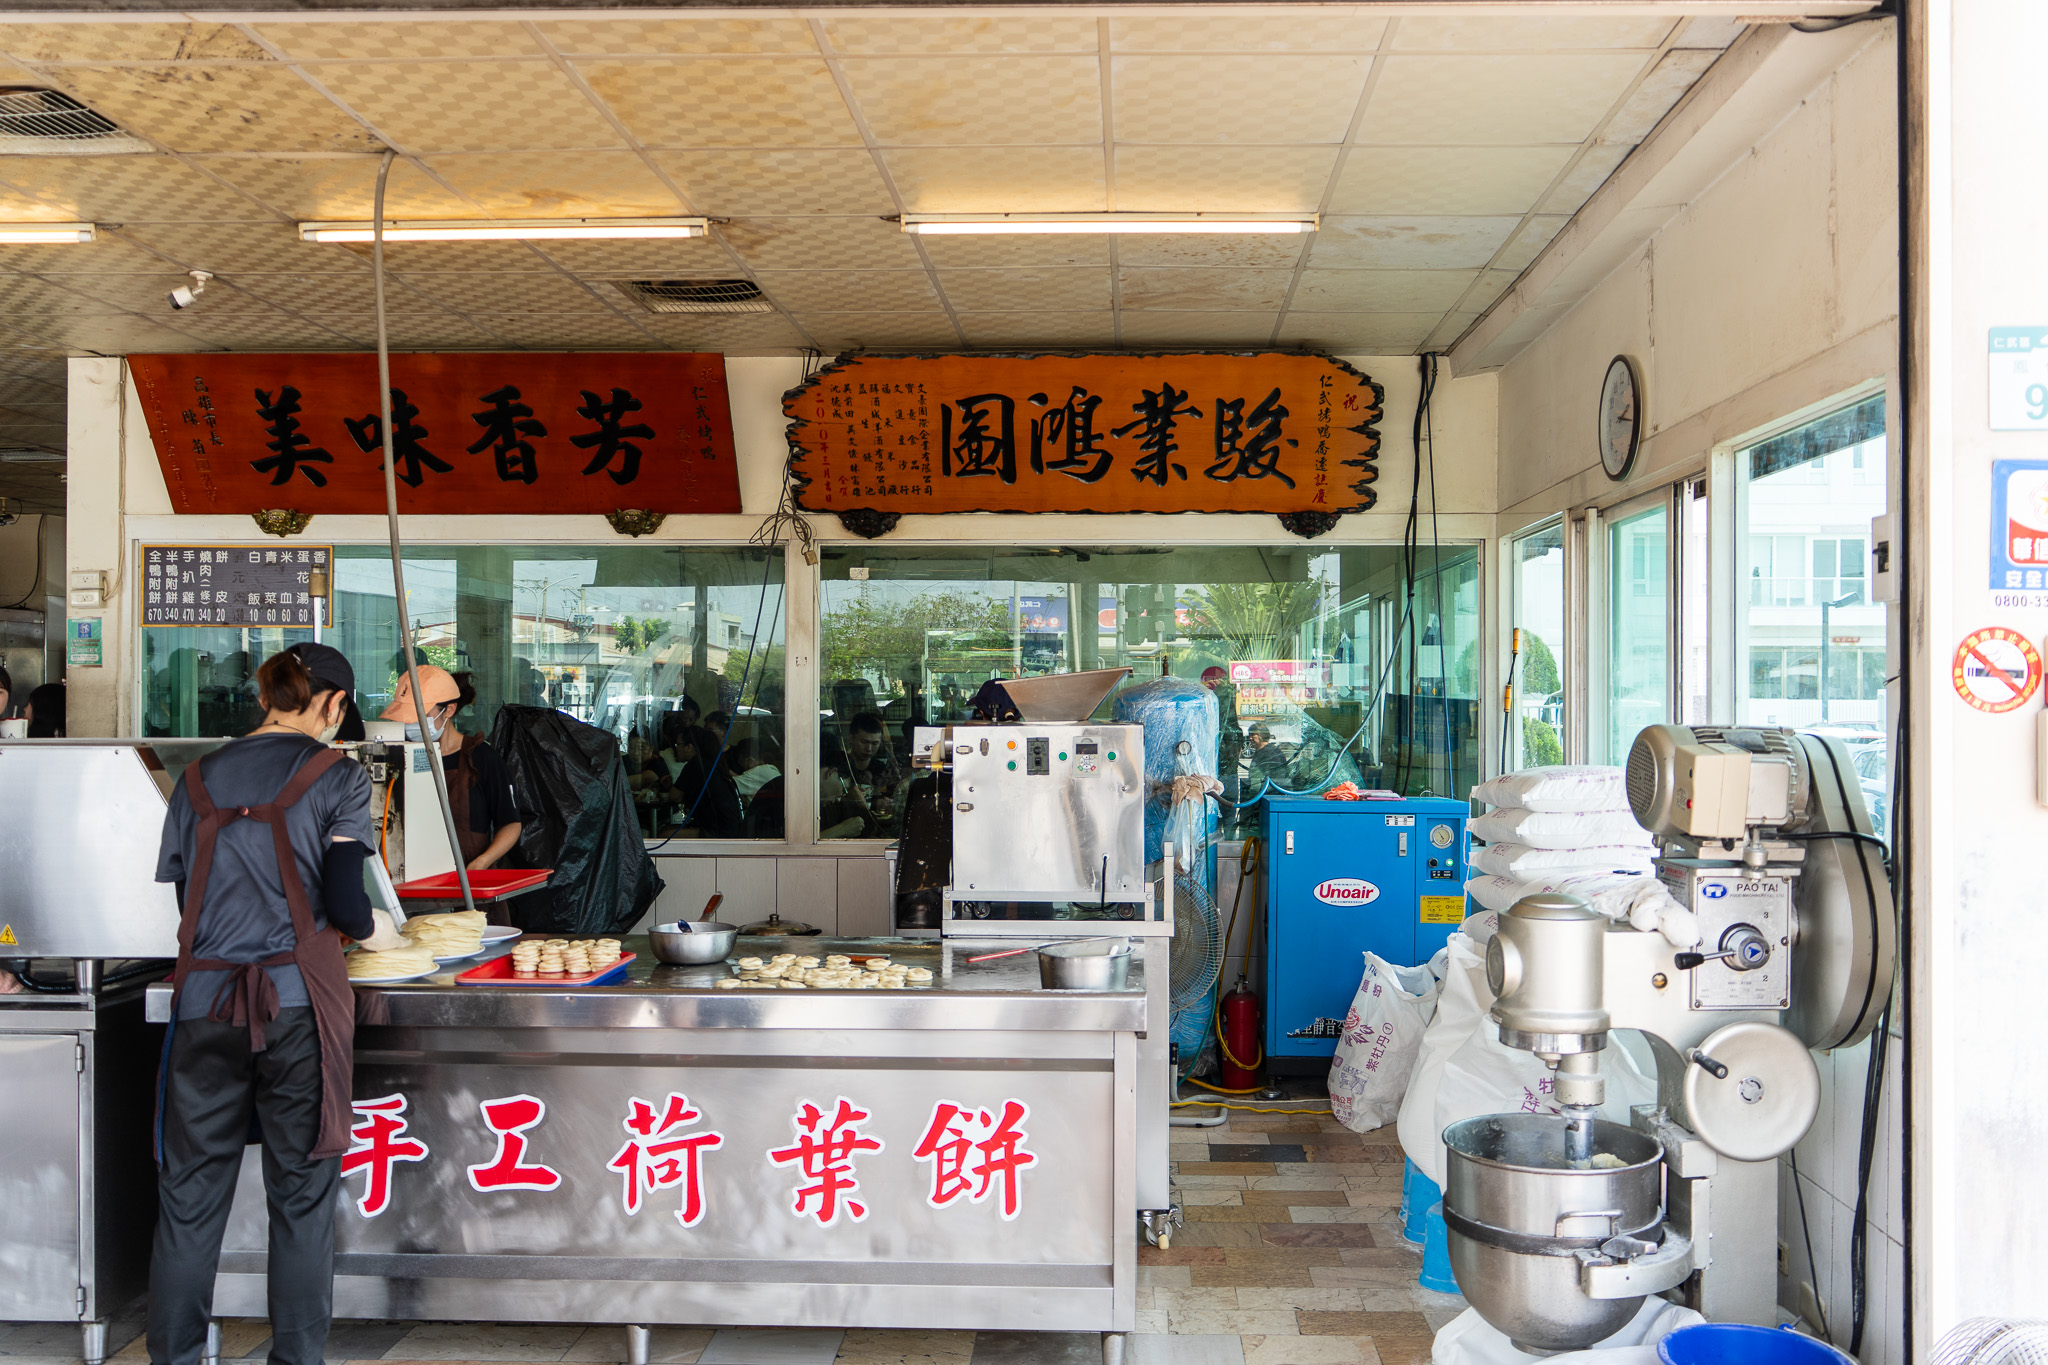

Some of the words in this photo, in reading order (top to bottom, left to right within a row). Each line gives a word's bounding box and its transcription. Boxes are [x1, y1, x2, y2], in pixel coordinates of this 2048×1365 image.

[1343, 393, 1359, 411] 祝
[692, 386, 716, 461] 仁武烤鴨
[148, 550, 161, 604] 全鴨附餅
[165, 550, 178, 604] 半鴨附餅
[182, 550, 195, 604] 手扒雞
[215, 550, 228, 604] 餅皮
[248, 550, 261, 606] 白飯
[264, 551, 278, 605] 青菜
[280, 551, 293, 604] 米血
[296, 551, 310, 605] 蛋花湯
[2005, 570, 2048, 589] 安全
[148, 607, 162, 621] 670
[164, 607, 179, 621] 340
[182, 608, 195, 621] 470
[198, 608, 211, 621] 340
[216, 608, 226, 621] 20
[249, 608, 259, 622] 10
[266, 608, 276, 622] 60
[281, 608, 291, 622] 60
[298, 608, 308, 622] 60
[1319, 883, 1374, 899] Unoair
[1736, 883, 1760, 892] PAO
[1762, 883, 1779, 892] TAI
[1763, 911, 1769, 919] 3
[1762, 974, 1769, 982] 2
[341, 1091, 1039, 1228] 手工荷葉餅
